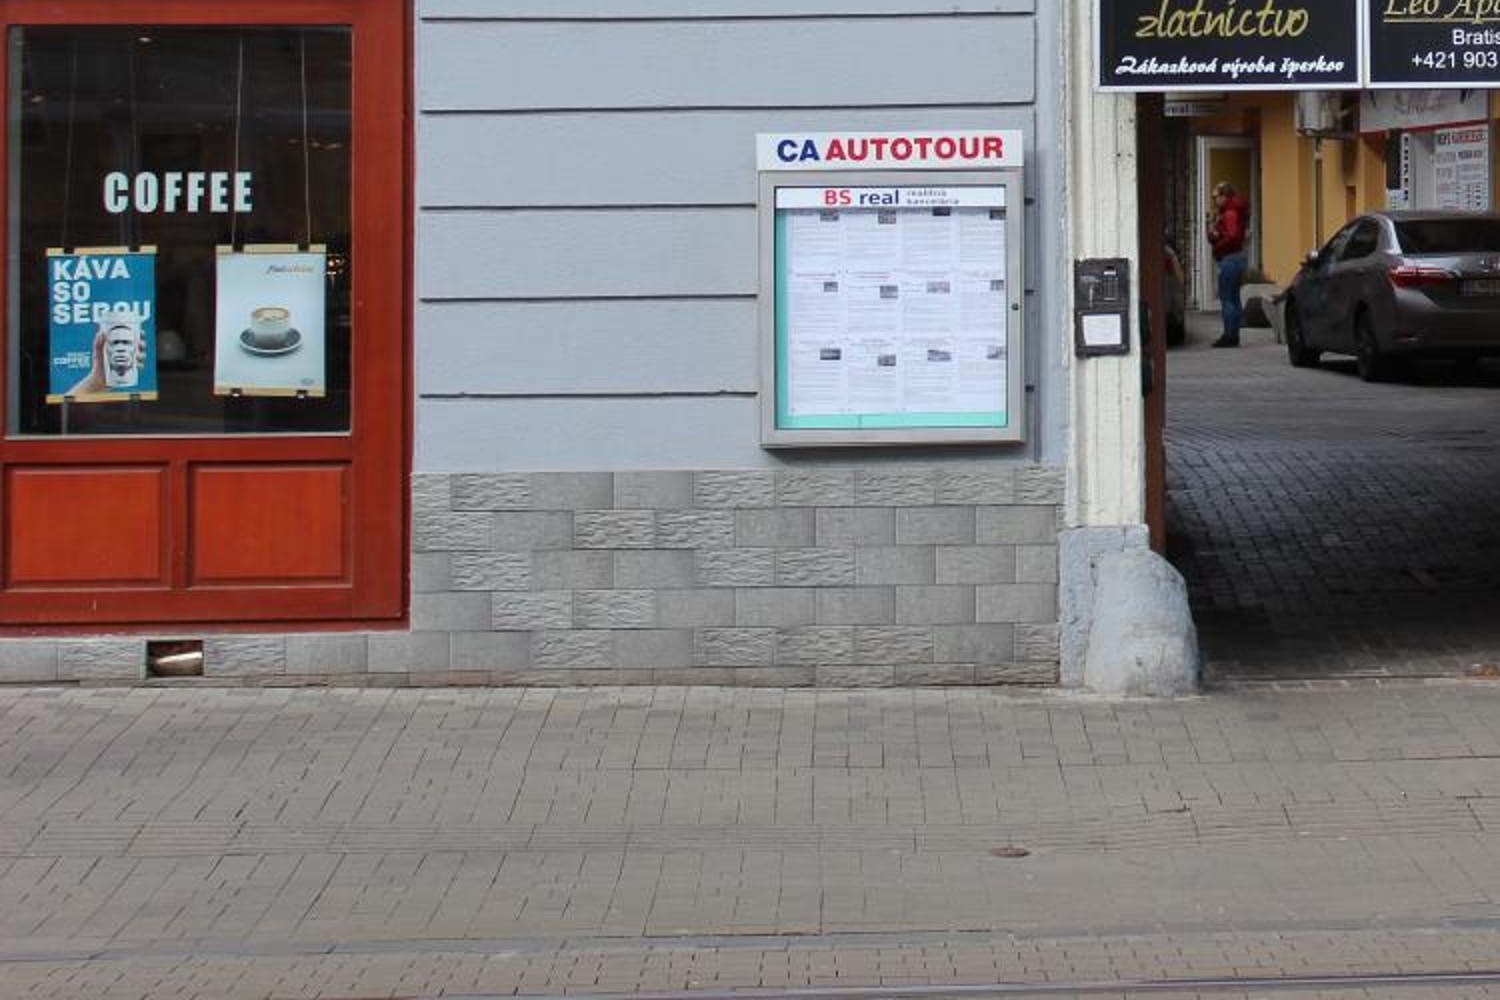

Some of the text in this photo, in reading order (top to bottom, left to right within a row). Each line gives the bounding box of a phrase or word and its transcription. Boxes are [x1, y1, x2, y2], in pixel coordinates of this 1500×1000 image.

[1221, 55, 1275, 79] výroba
[1279, 55, 1344, 79] šperkov
[1411, 52, 1455, 68] +421
[1463, 51, 1498, 68] 903
[777, 137, 1003, 162] CA AUTOTOUR
[104, 171, 252, 213] COFFEE
[824, 189, 899, 205] BS real
[53, 256, 131, 281] KÁVA
[53, 281, 91, 303] SO
